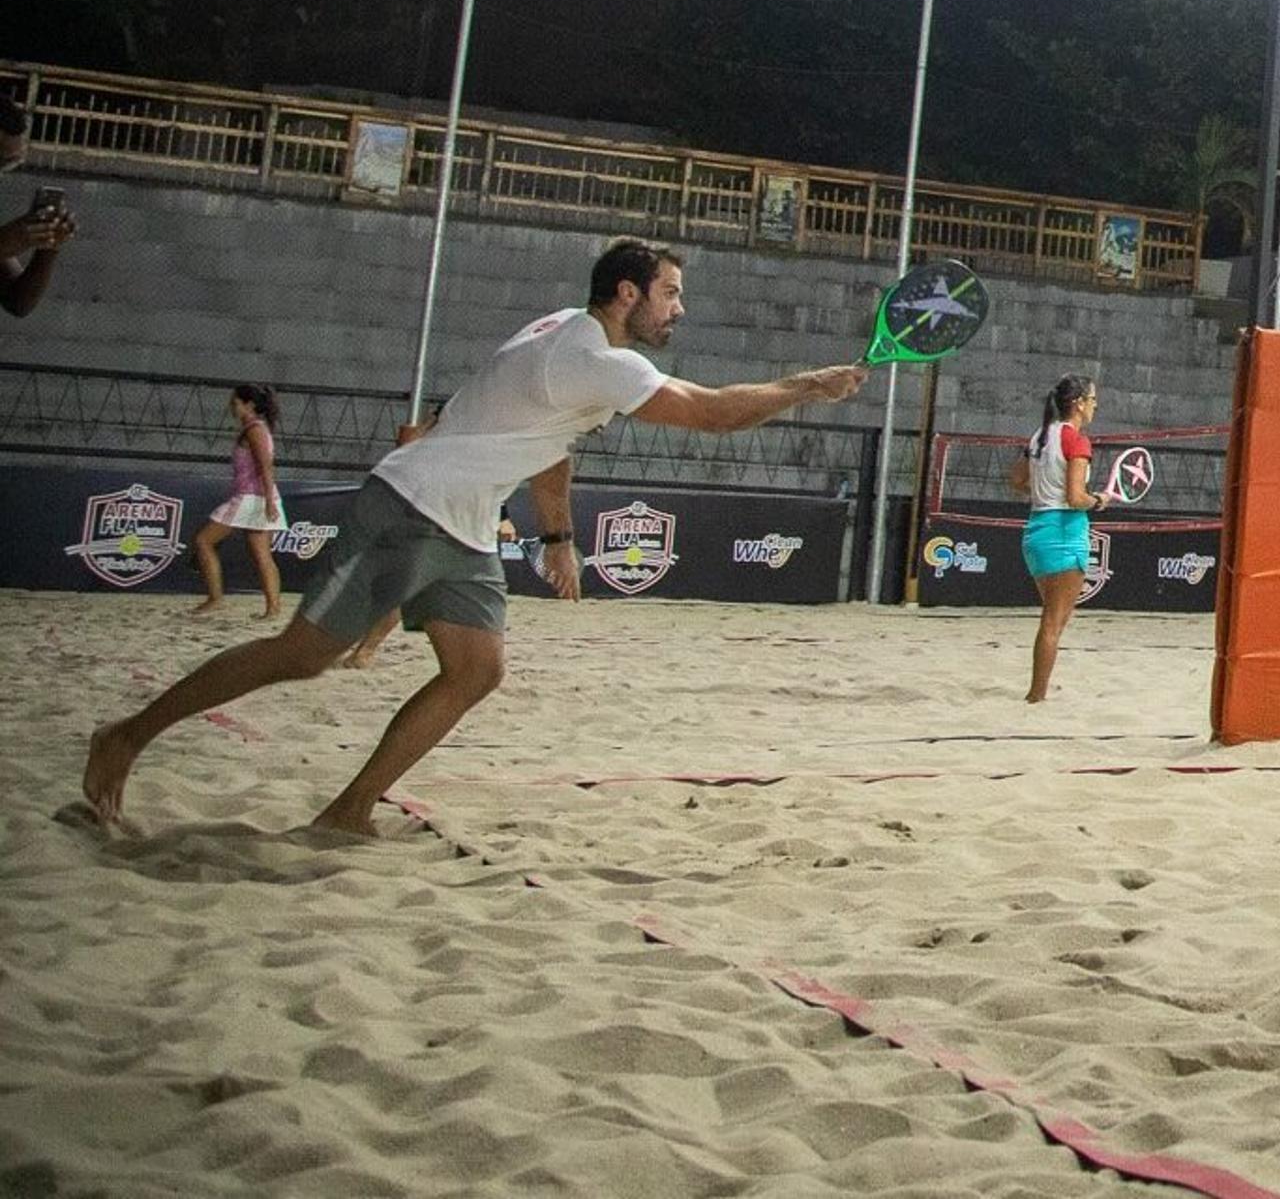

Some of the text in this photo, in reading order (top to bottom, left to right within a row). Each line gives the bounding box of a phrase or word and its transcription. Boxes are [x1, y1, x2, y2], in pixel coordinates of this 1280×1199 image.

[102, 502, 167, 520] ARENA
[291, 522, 339, 537] Clean
[610, 518, 663, 534] ARENA
[734, 539, 794, 569] Whey
